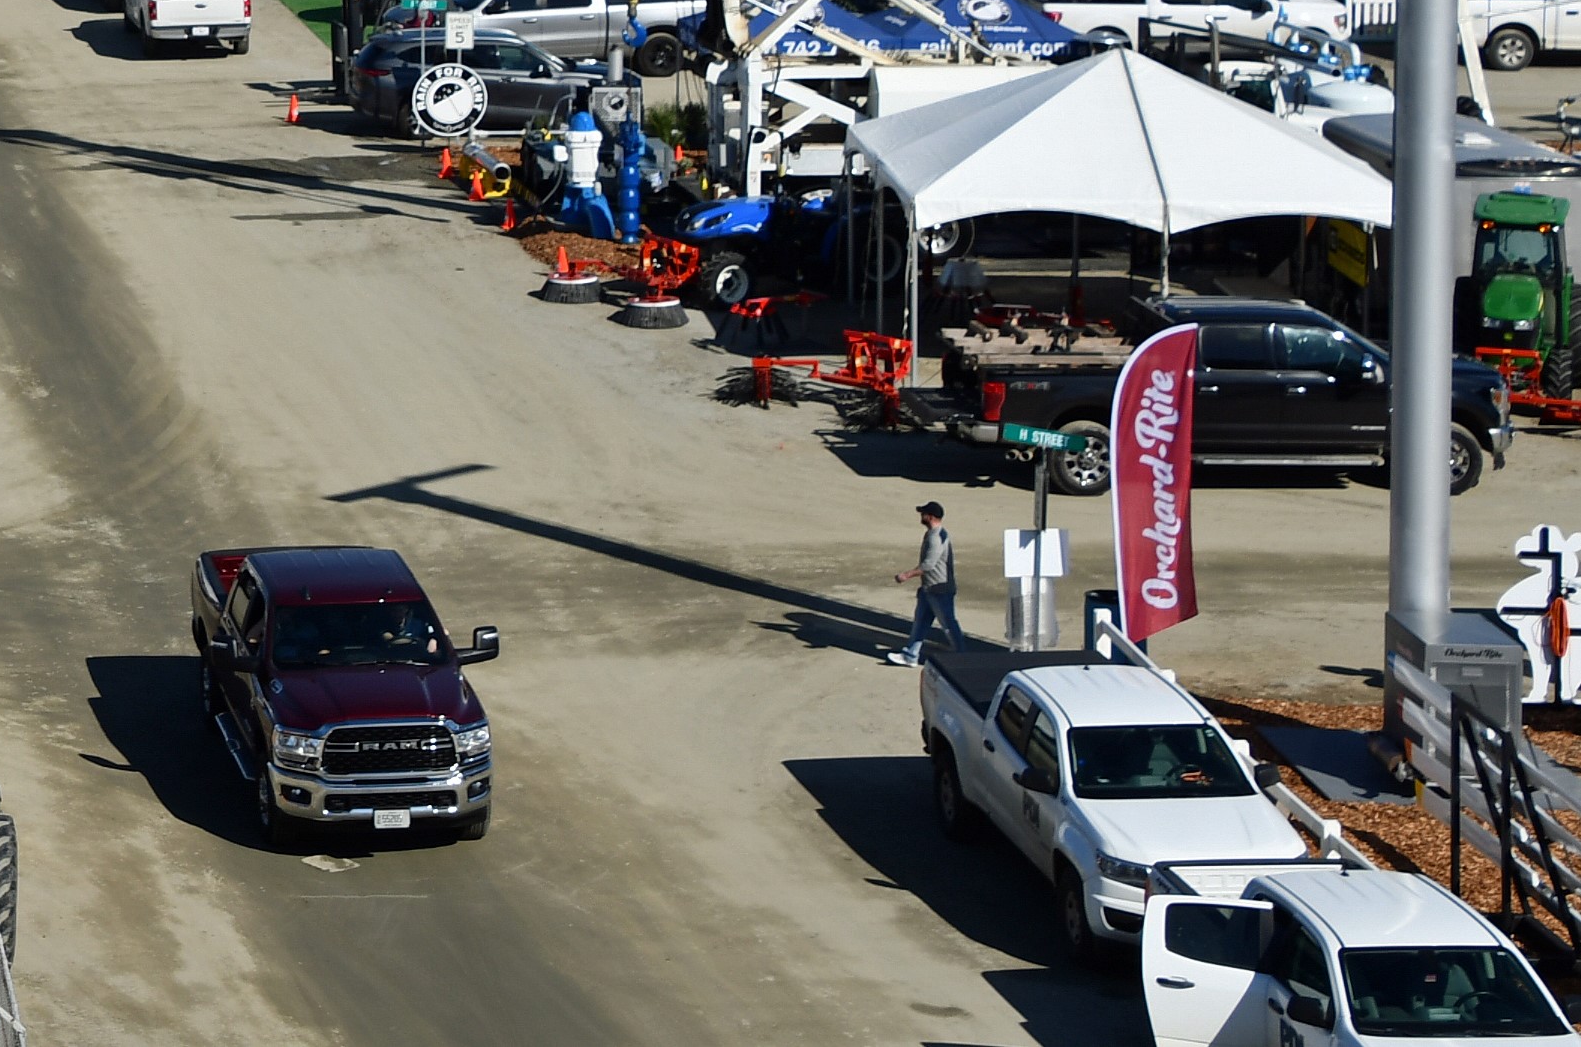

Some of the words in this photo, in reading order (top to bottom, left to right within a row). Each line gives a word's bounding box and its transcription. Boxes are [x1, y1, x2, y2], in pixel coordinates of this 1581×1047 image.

[455, 32, 465, 44] 5
[416, 77, 432, 111] RAIN
[434, 67, 464, 78] FOR
[467, 75, 484, 112] RENT
[1019, 428, 1028, 441] H
[1031, 430, 1070, 448] STREET
[1134, 369, 1180, 609] Orchard-Rite
[363, 741, 419, 750] RAM
